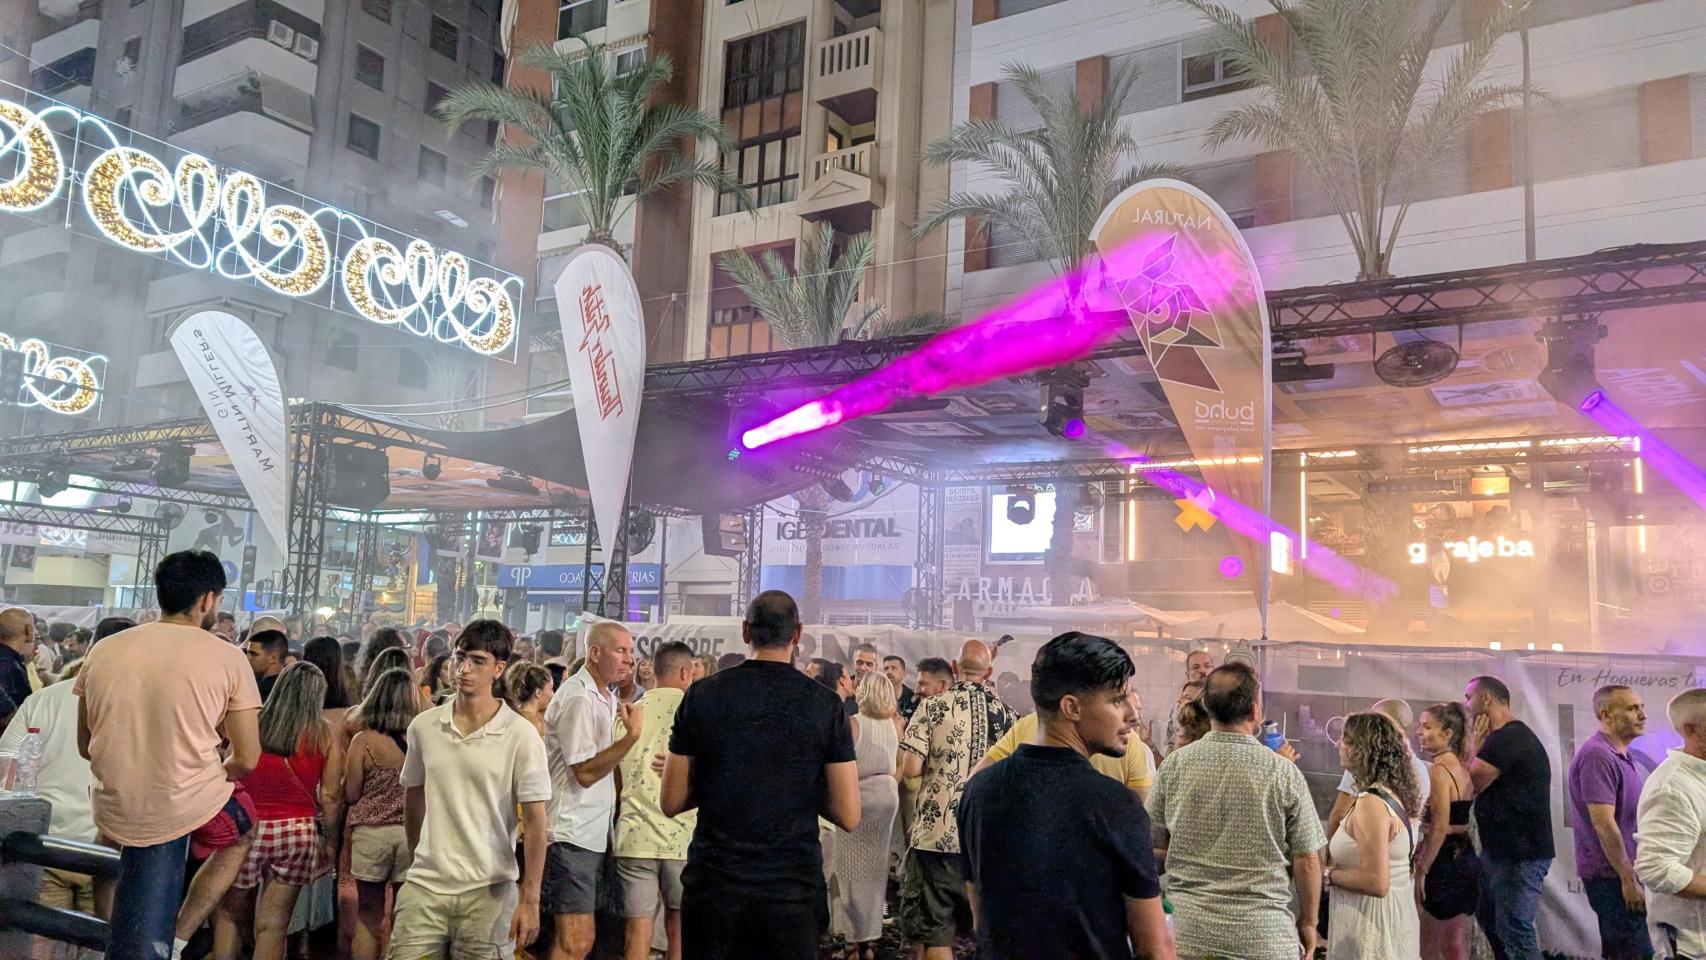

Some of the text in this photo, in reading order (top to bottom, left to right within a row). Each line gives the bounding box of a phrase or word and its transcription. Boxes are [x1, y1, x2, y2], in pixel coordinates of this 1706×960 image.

[823, 518, 902, 539] DENTAL
[957, 576, 1093, 601] ARMACA
[1558, 667, 1585, 687] En
[1591, 669, 1680, 687] Hogueras
